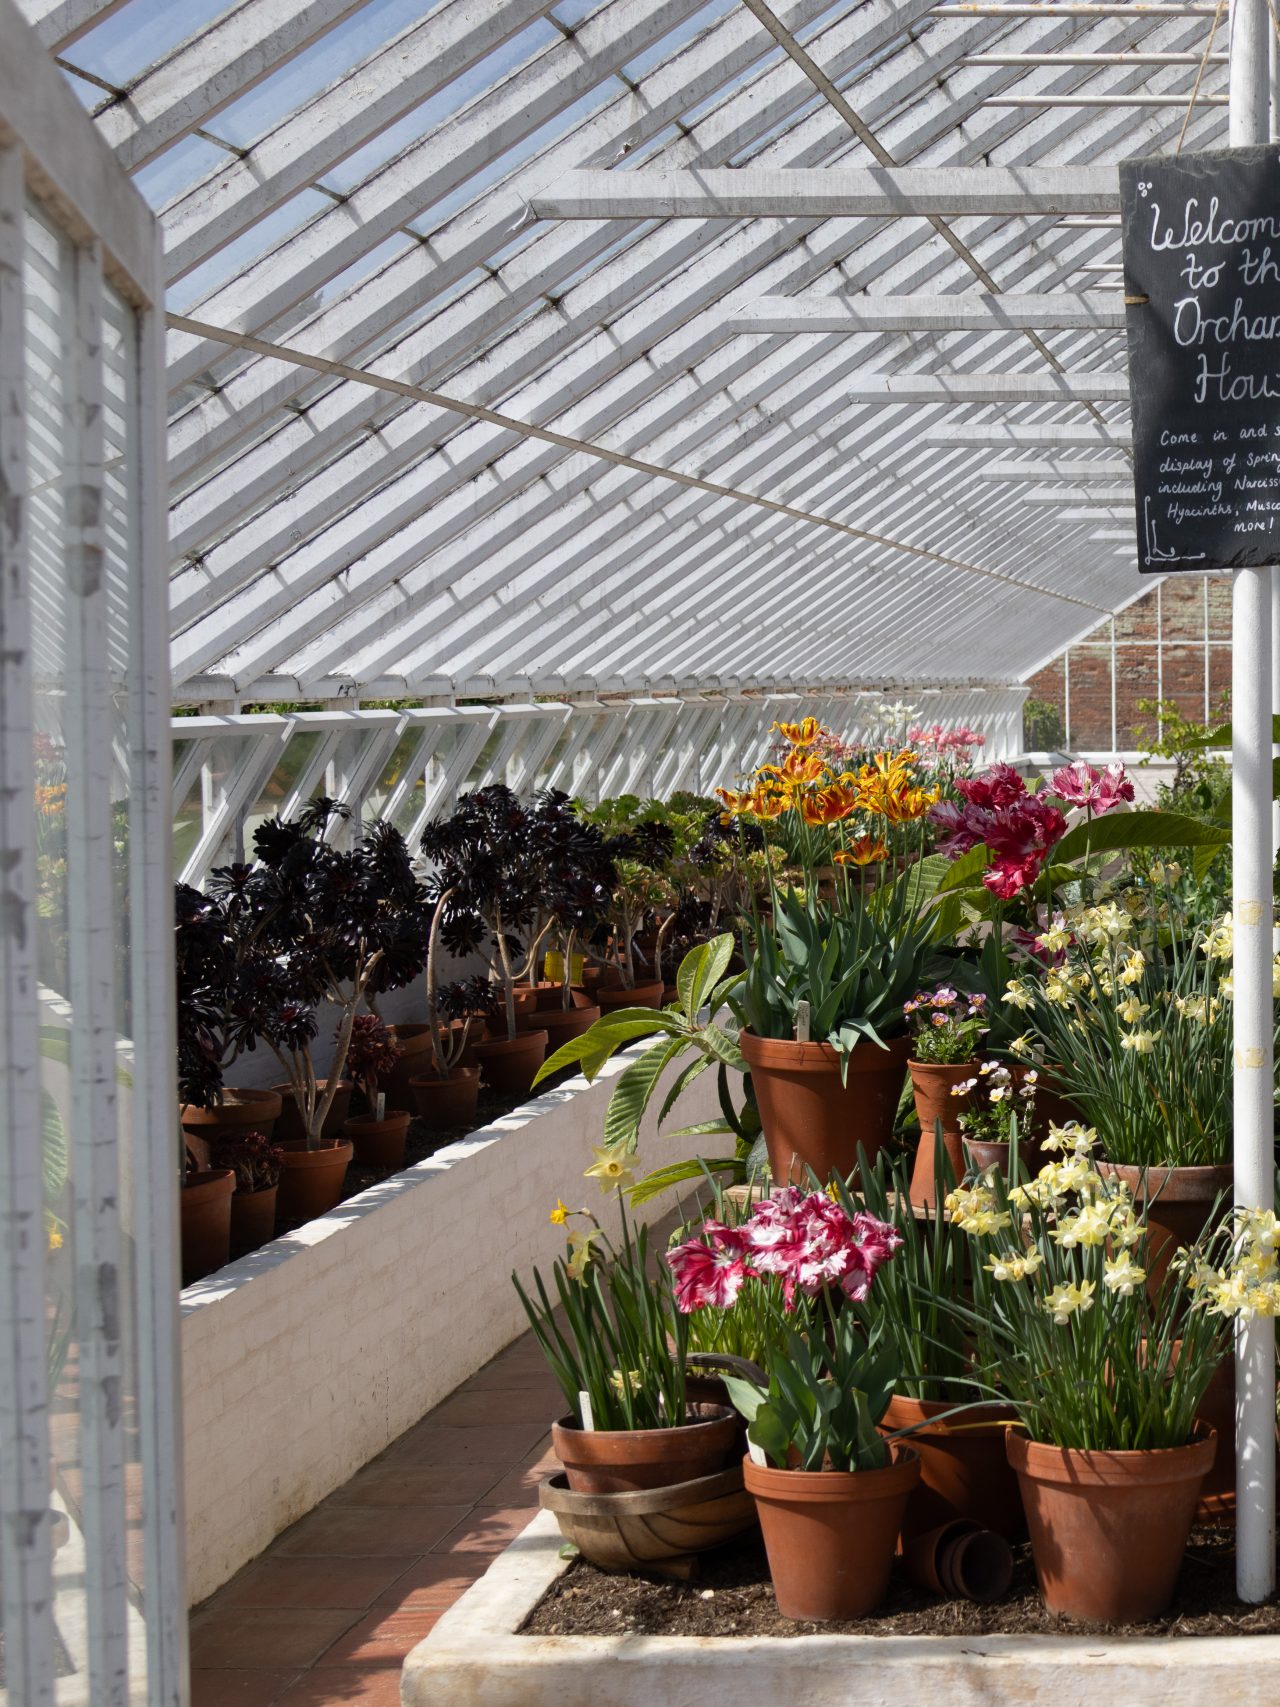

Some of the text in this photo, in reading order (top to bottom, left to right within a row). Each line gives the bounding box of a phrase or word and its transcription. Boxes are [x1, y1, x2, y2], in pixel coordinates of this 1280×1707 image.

[1180, 253, 1226, 289] to
[1160, 430, 1198, 446] Come
[1213, 429, 1228, 441] in
[1239, 423, 1267, 439] and
[1159, 456, 1213, 479] display
[1222, 452, 1236, 475] of
[1158, 480, 1222, 502] including
[1167, 501, 1239, 525] Hyacinths,
[1233, 516, 1274, 534] more!
